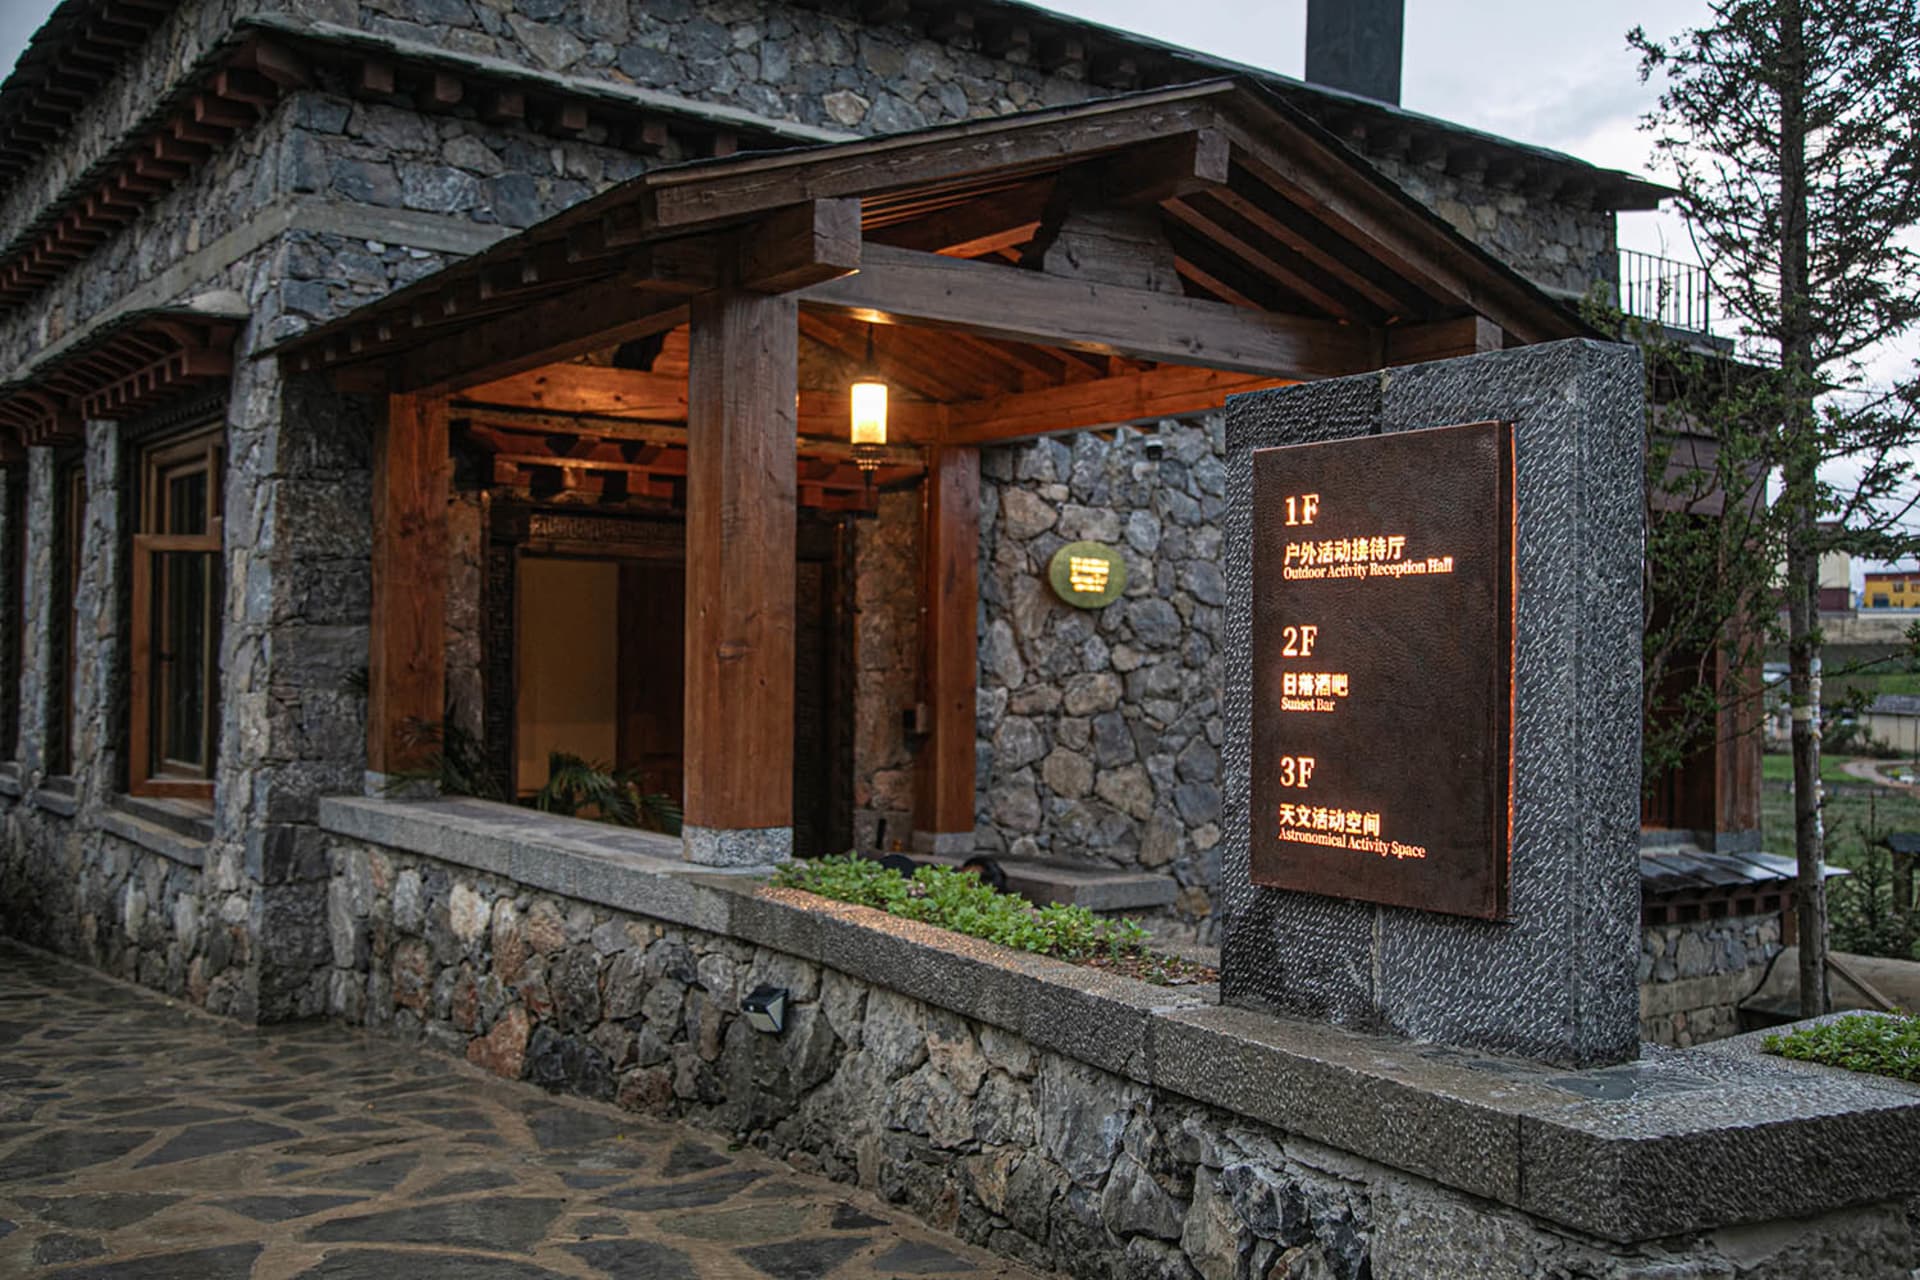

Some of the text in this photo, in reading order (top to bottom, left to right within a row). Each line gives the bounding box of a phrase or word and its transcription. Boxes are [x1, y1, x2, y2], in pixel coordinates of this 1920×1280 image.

[1285, 494, 1319, 526] 1F
[1284, 536, 1406, 565] 户外活动接待厅
[1284, 557, 1453, 580] Outdoor Activity Reception Hall
[1282, 625, 1318, 657] 2F
[1282, 673, 1348, 697] 日落酒吧
[1281, 697, 1335, 712] Sunset Bar
[1280, 756, 1315, 788] 3F
[1279, 803, 1380, 837] 天文活动空间
[1279, 827, 1426, 859] Astronomical Activity Space
